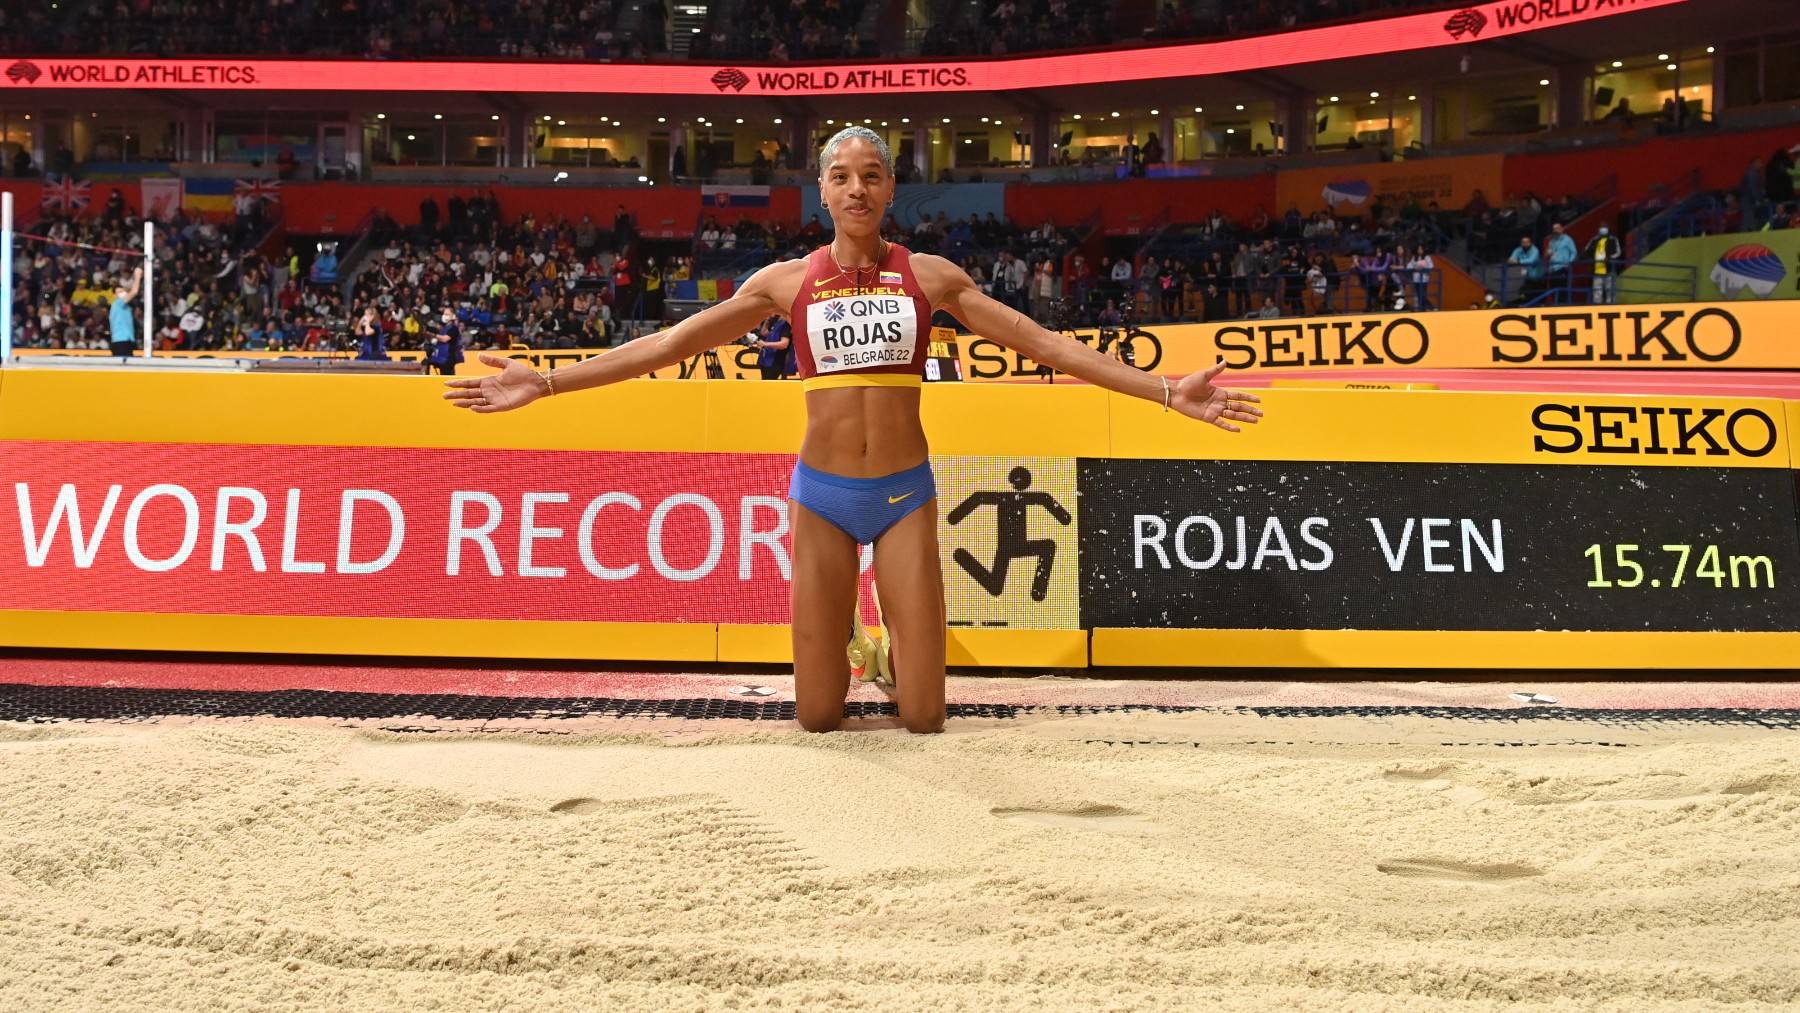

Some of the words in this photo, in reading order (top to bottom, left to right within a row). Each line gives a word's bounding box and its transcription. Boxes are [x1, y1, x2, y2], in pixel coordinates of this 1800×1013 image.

[1496, 0, 1589, 29] WORLD
[50, 65, 130, 82] WORLD
[757, 72, 840, 90] WORLD
[811, 286, 906, 300] VENEZUELA
[850, 299, 900, 317] QNB
[822, 321, 902, 350] ROJAS
[1214, 317, 1429, 370] SEIKO
[1490, 307, 1742, 363] SEIKO
[843, 349, 895, 366] BELGRADE
[896, 349, 910, 361] 22
[1531, 403, 1777, 458] SEIKO
[15, 482, 405, 574] WORLD
[446, 490, 874, 583] RECOR
[1132, 513, 1334, 573] ROJAS
[1366, 517, 1506, 574] VEN
[1584, 542, 1775, 591] 15.74m
